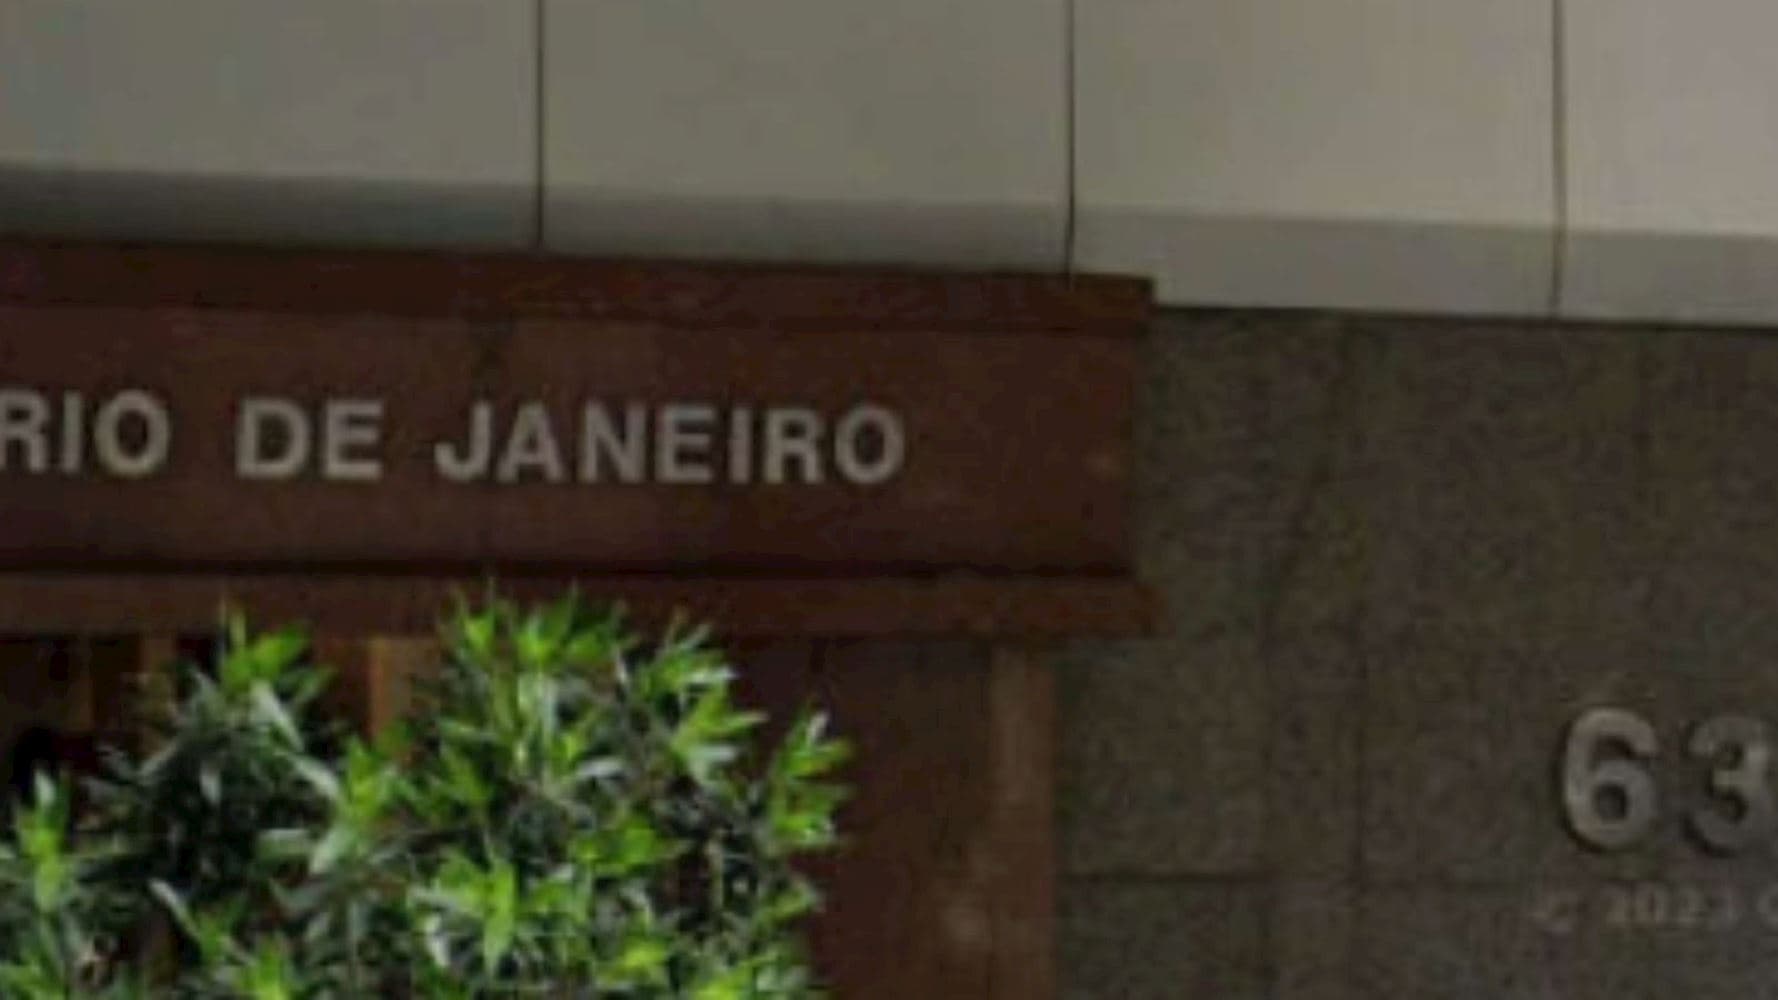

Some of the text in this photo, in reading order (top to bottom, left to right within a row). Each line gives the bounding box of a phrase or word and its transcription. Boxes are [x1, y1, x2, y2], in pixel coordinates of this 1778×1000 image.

[0, 389, 906, 485] RIO DE JANEIRO
[1563, 707, 1774, 852] 63
